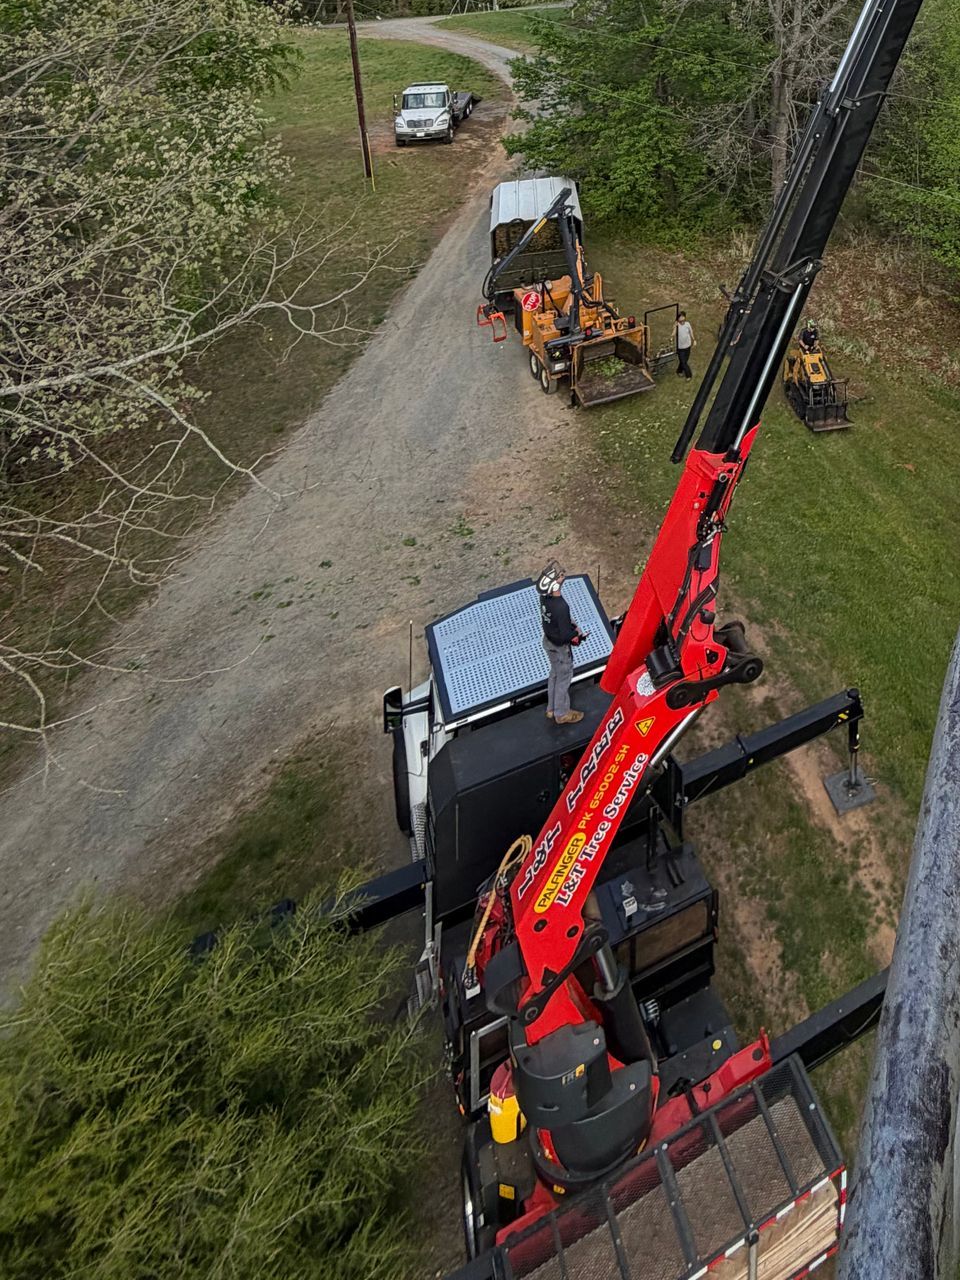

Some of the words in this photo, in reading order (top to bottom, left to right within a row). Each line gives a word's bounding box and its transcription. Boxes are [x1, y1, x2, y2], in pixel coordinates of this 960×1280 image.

[525, 292, 537, 310] STOP
[518, 821, 561, 900] L&T
[566, 707, 624, 813] TREE
[555, 864, 587, 907] L&T
[578, 821, 611, 862] Tree
[603, 752, 649, 819] Service
[578, 811, 594, 830] PK
[537, 837, 583, 908] PALFINGER
